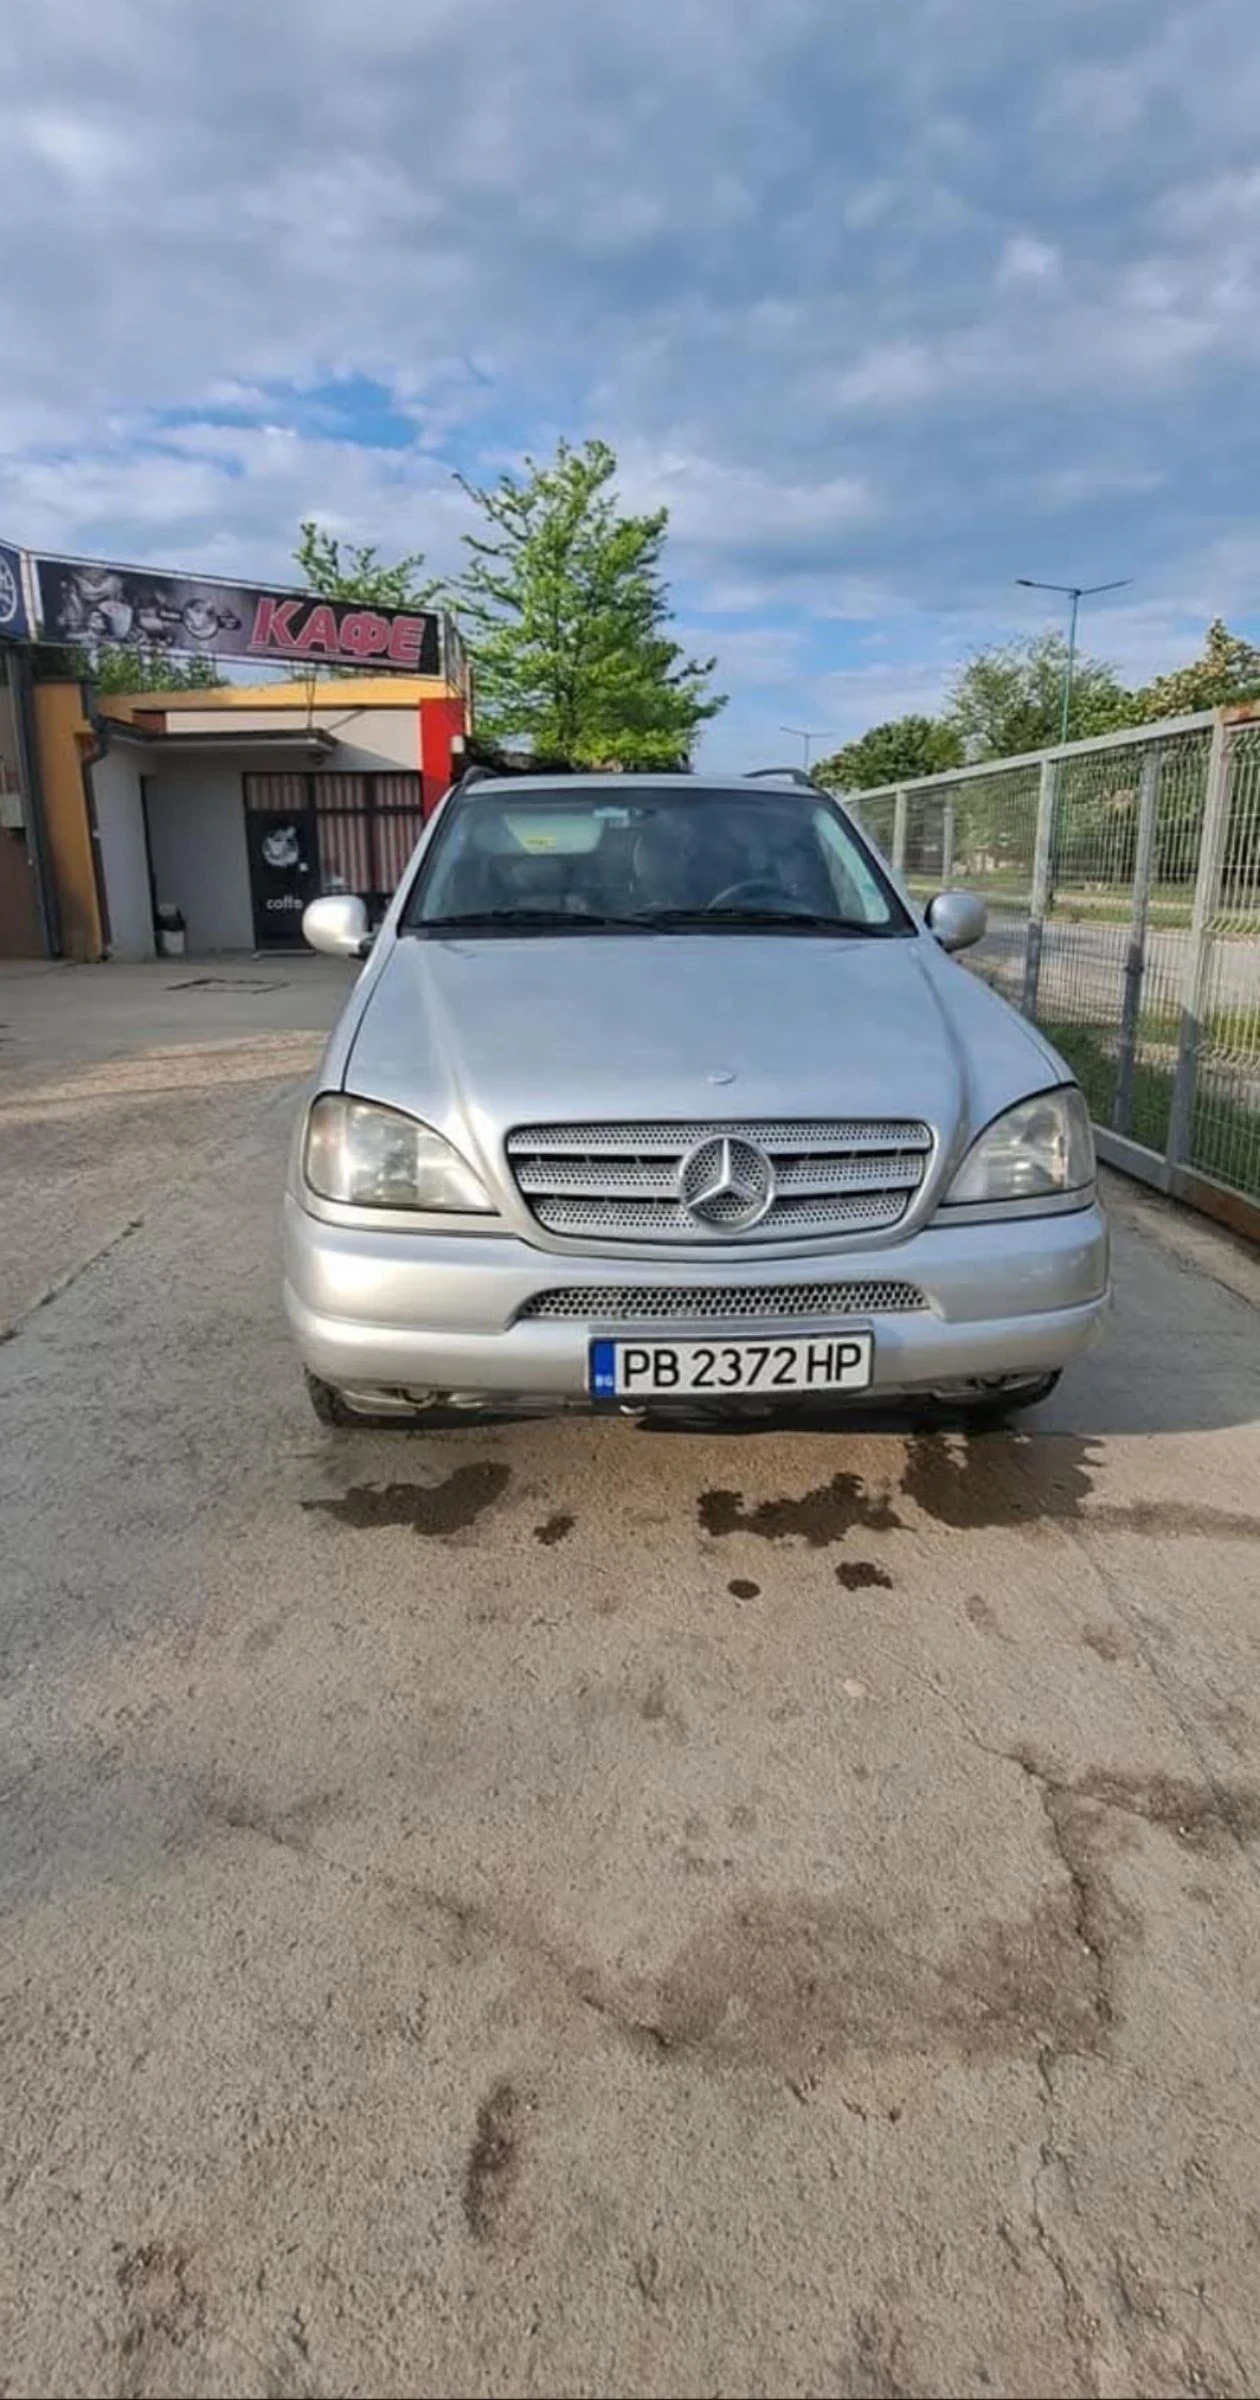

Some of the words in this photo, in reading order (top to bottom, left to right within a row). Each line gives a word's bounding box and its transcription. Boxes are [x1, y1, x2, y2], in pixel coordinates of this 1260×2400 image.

[251, 597, 426, 662] КАФЕ
[623, 1349, 680, 1388] PB
[690, 1346, 798, 1387] 2372
[806, 1343, 862, 1383] HP
